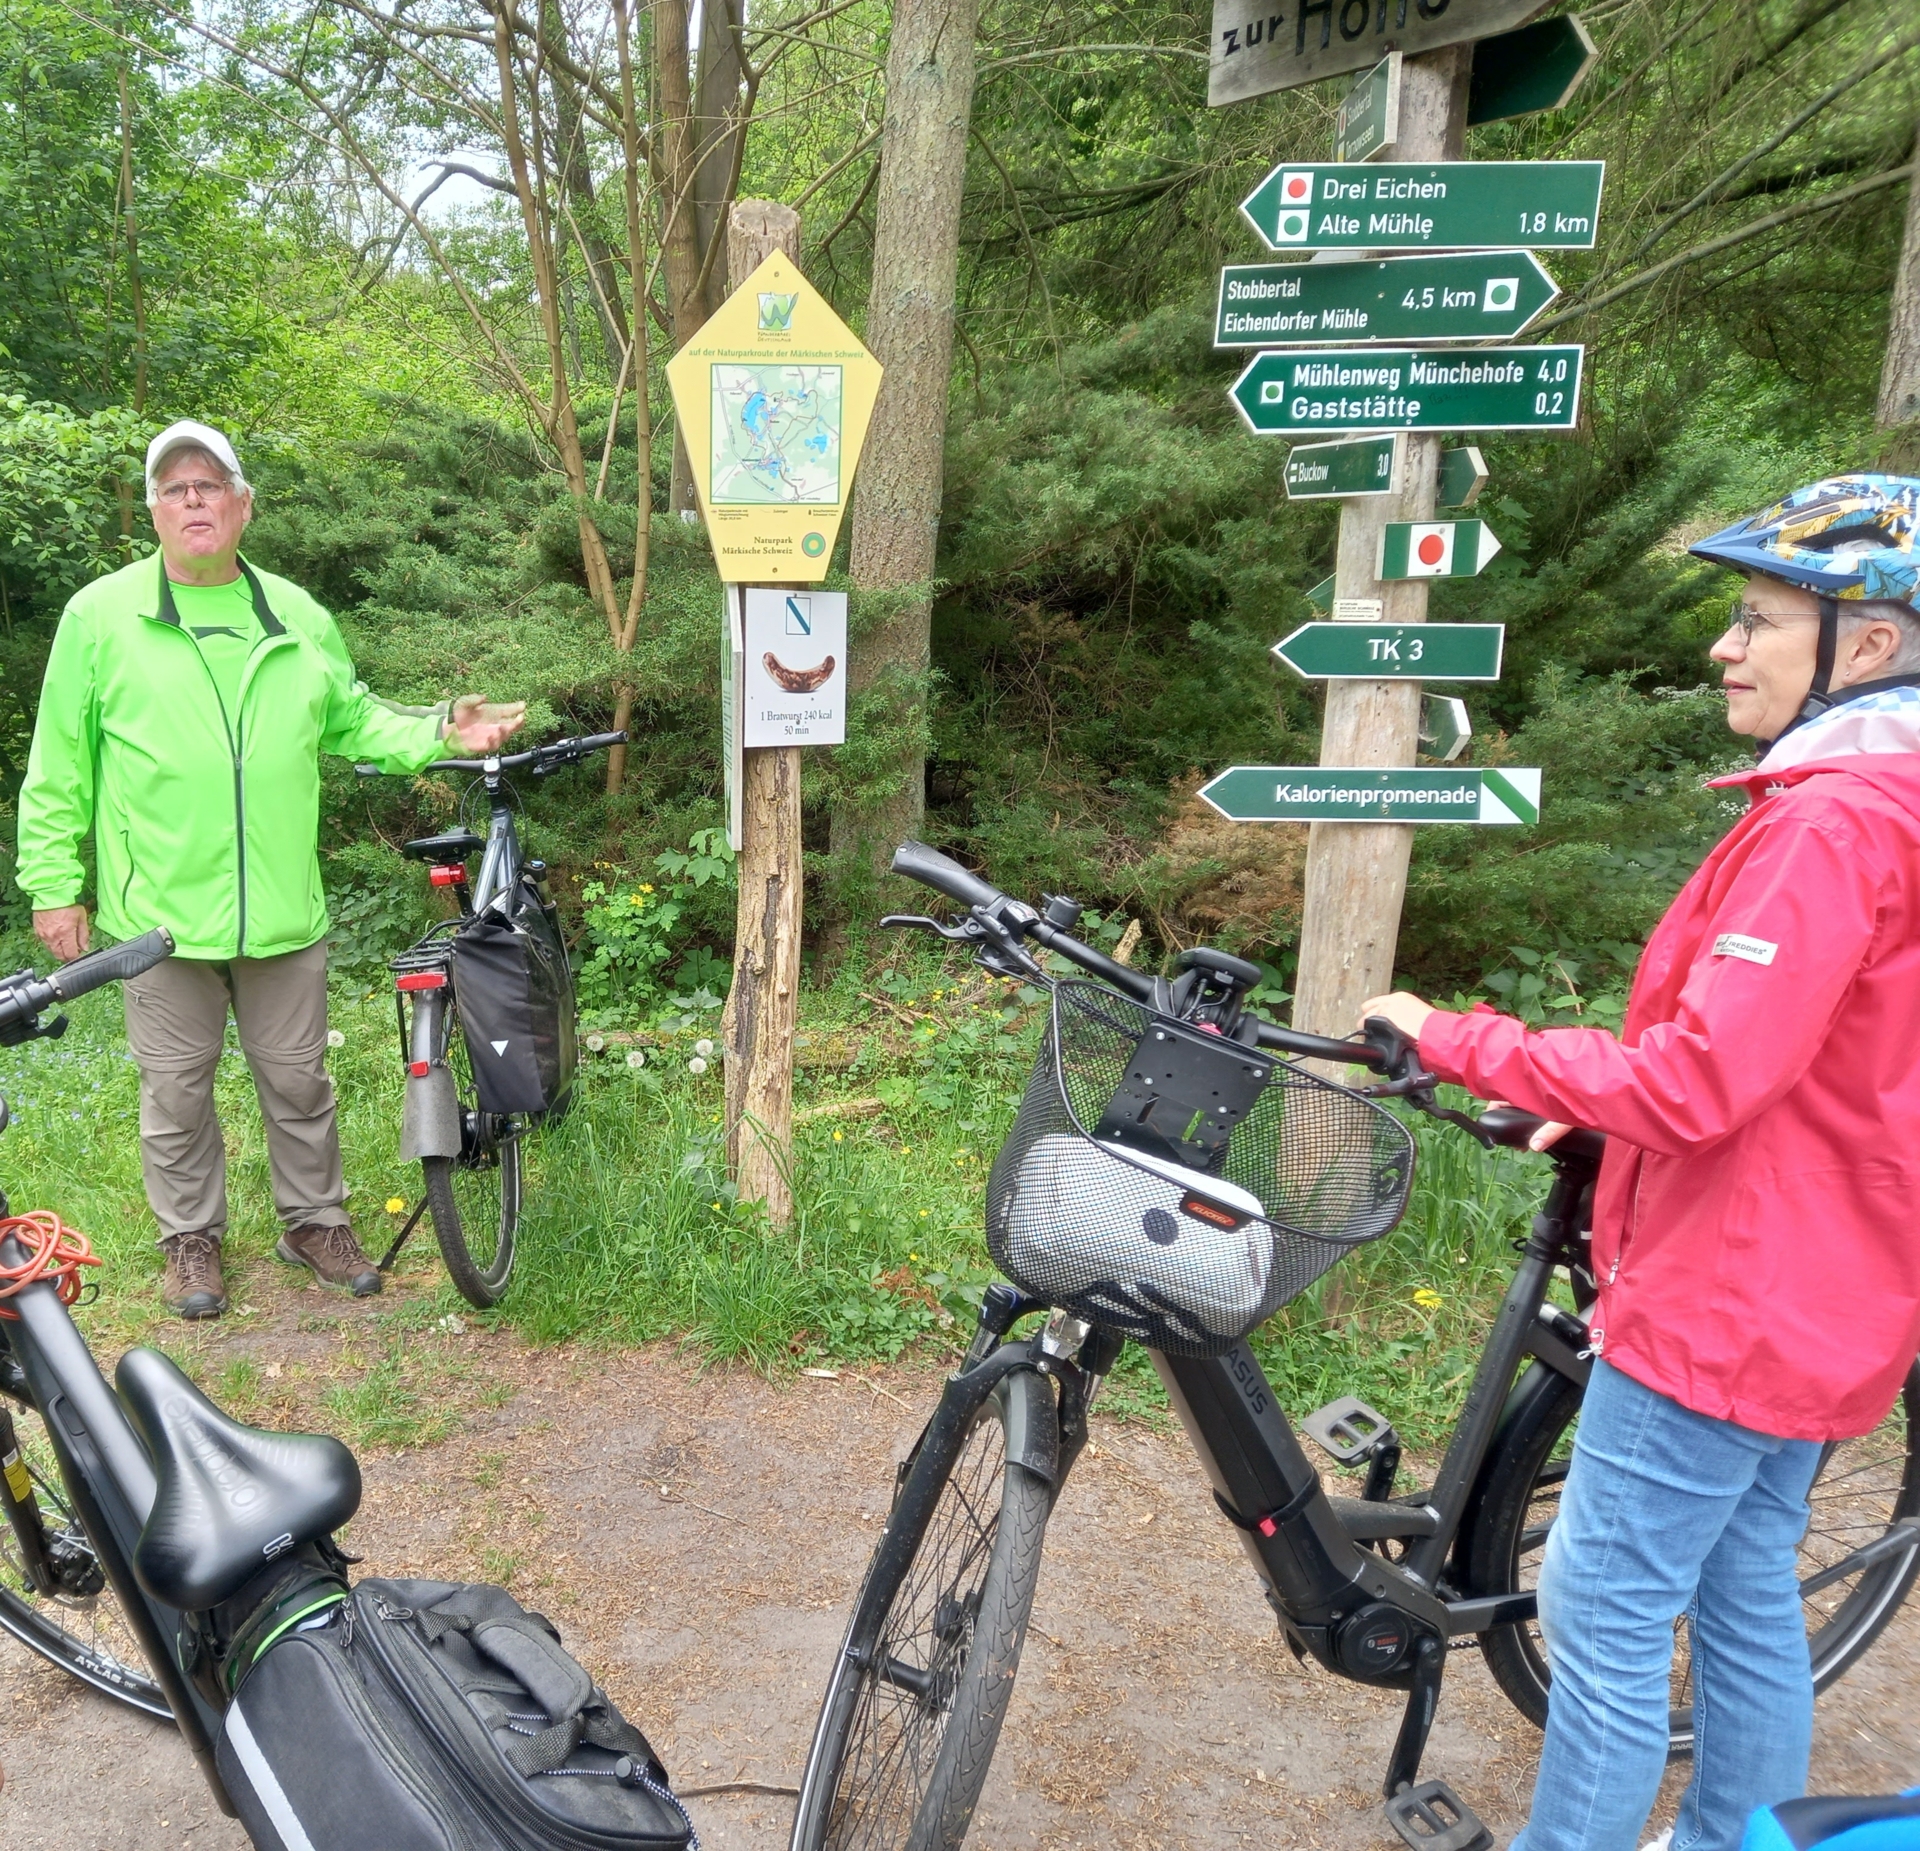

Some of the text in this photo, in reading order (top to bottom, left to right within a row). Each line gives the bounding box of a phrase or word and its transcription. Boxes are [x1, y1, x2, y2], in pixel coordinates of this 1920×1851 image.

[1223, 14, 1284, 56] zur
[1323, 178, 1446, 200] Drei Eichen
[1318, 212, 1588, 236] Alte Mühle 1,8 km
[1227, 277, 1301, 301] Stobbertal
[1402, 286, 1475, 311] 4,5 km
[1224, 308, 1368, 333] Eichendorfer Mühle
[688, 348, 864, 358] auf der Naturparkroute der Märkischen Schweiz
[1294, 358, 1567, 391] Mühlenweg Münchehofe 4,0
[1291, 391, 1563, 420] Gaststätte 0,2
[1298, 453, 1389, 482] Buckow 3,0
[722, 546, 793, 555] Märkische Schweiz
[753, 536, 793, 546] Naturpark
[1368, 639, 1424, 660] TK 3
[767, 710, 803, 721] Bratwurst
[804, 710, 818, 721] 240
[818, 709, 833, 720] kcal
[784, 724, 810, 736] 50 min
[1276, 784, 1477, 809] Kalorienpromenade
